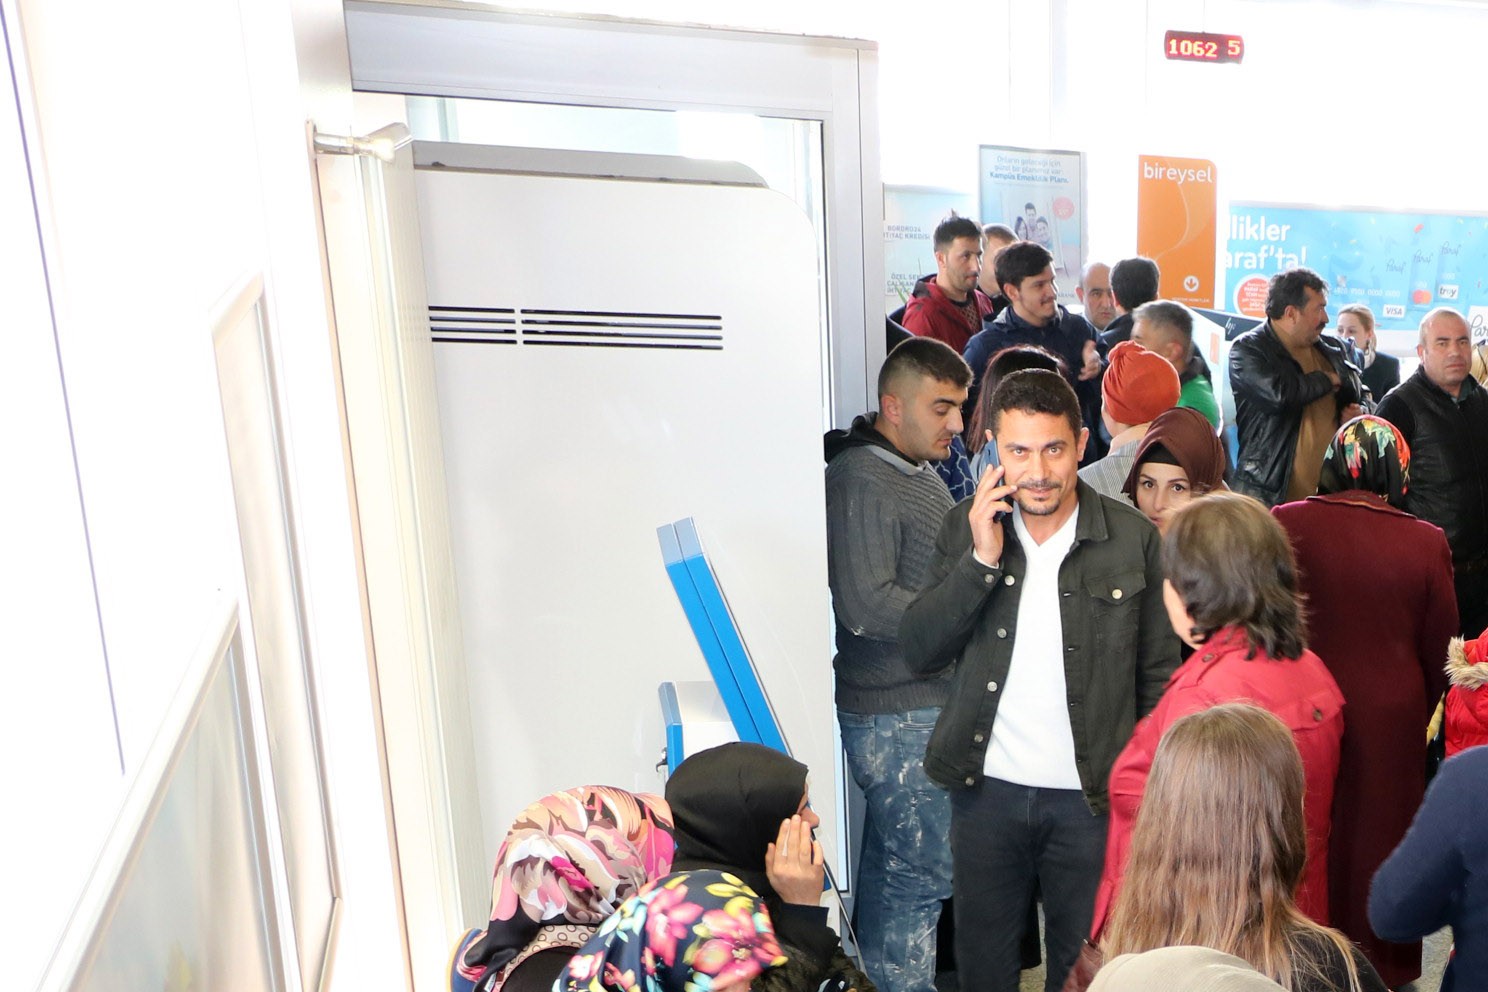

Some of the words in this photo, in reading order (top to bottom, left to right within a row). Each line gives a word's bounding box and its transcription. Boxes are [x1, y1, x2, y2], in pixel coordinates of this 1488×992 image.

[1169, 39, 1217, 57] 1062
[1227, 40, 1240, 55] 5
[1143, 162, 1213, 184] bireysel
[1440, 286, 1457, 297] troy
[1386, 306, 1403, 315] VISA
